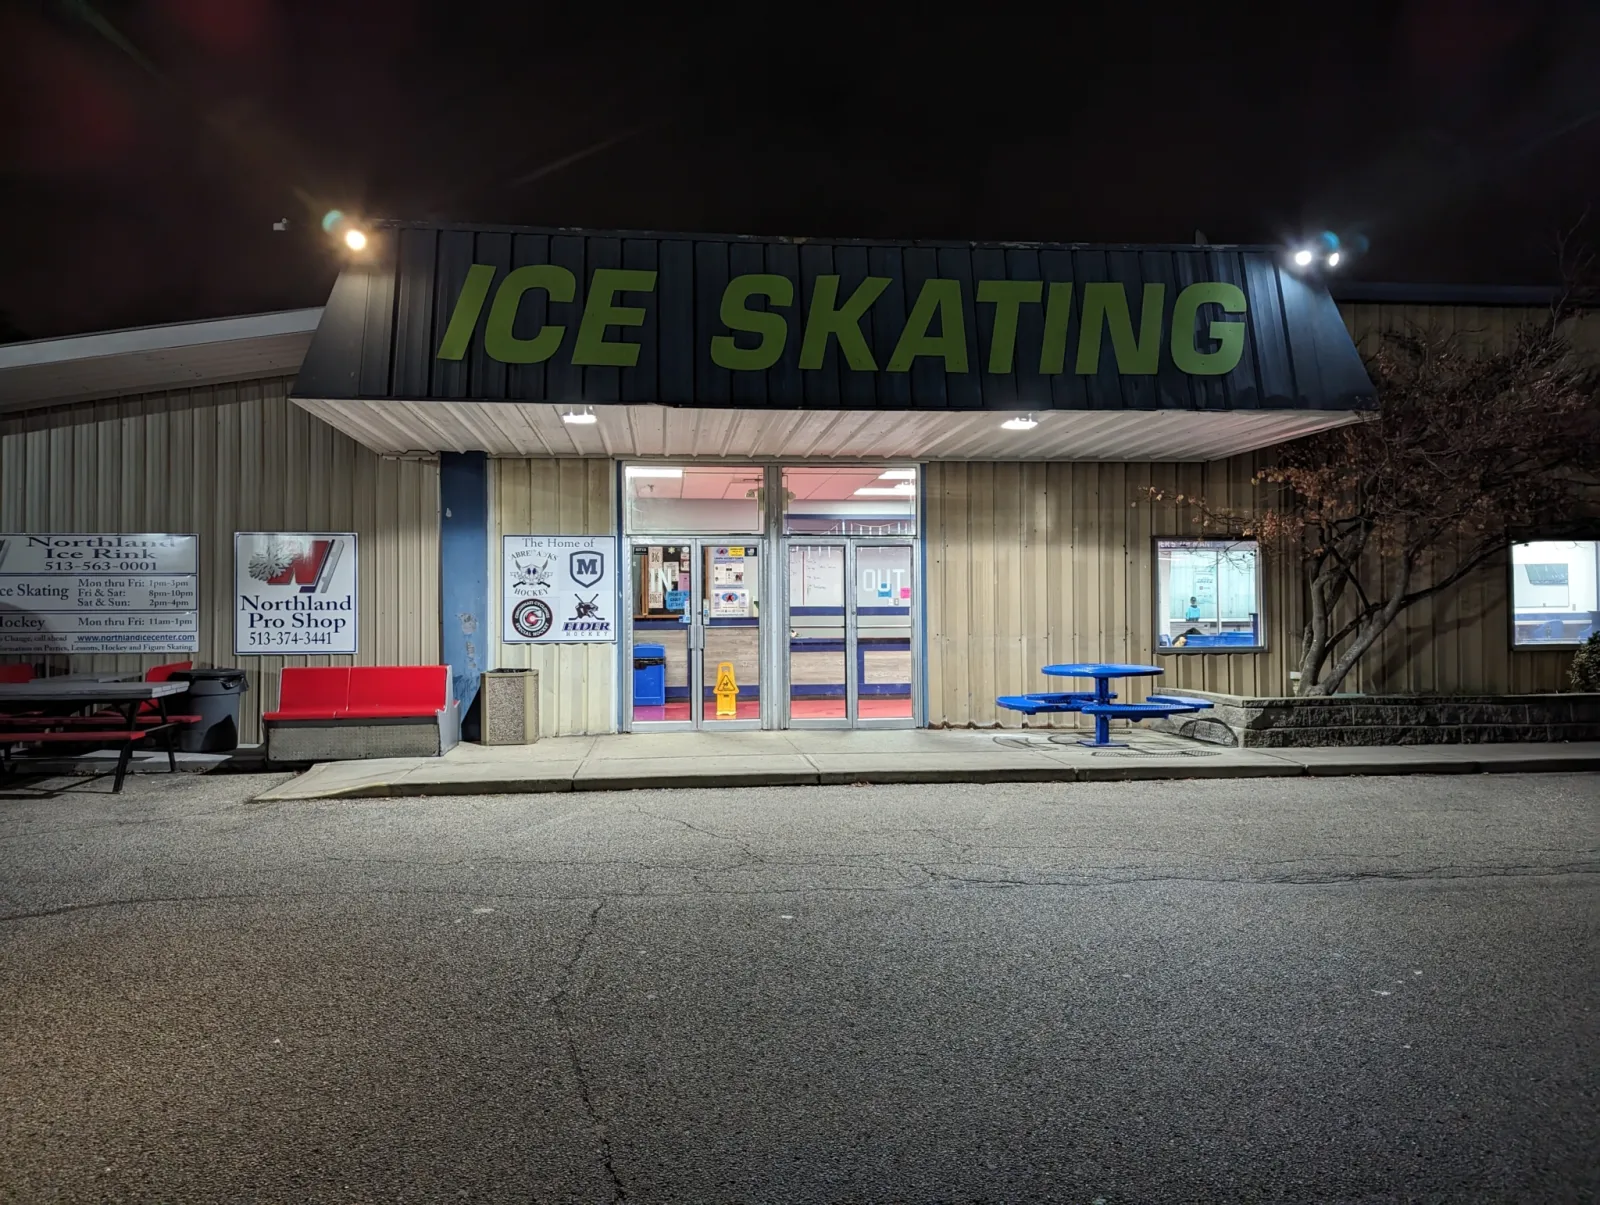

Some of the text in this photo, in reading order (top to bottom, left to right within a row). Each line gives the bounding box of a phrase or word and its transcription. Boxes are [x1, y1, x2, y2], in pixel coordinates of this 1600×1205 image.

[436, 264, 1248, 376] ICE SKATING
[26, 536, 176, 547] Northland
[522, 537, 595, 547] The Home of
[44, 548, 157, 558] Ice Rink
[44, 561, 157, 571] 513-563-0001
[576, 558, 598, 575] M
[78, 579, 145, 587] Mon thru Fri:
[149, 580, 189, 588] 1pm-3pm
[650, 568, 672, 592] IN
[863, 568, 905, 592] OUT
[0, 583, 69, 600] ce Skating
[78, 588, 126, 597] Fri & Sat:
[148, 590, 194, 598] 8pm-10pm
[514, 588, 548, 596] HOCKEY
[77, 598, 131, 607] Sat & Sun:
[149, 599, 189, 607] 2pm-4pm
[240, 595, 352, 611] Northland
[0, 616, 46, 630] ockey
[78, 617, 193, 626] Mon thru Fri: 11am-1pm
[248, 612, 346, 633] Pro Shop
[563, 622, 611, 631] ELDER
[249, 631, 332, 645] 513-374-3441
[101, 644, 127, 652] Hockey
[143, 644, 165, 652] Figure
[166, 644, 193, 652] Skating
